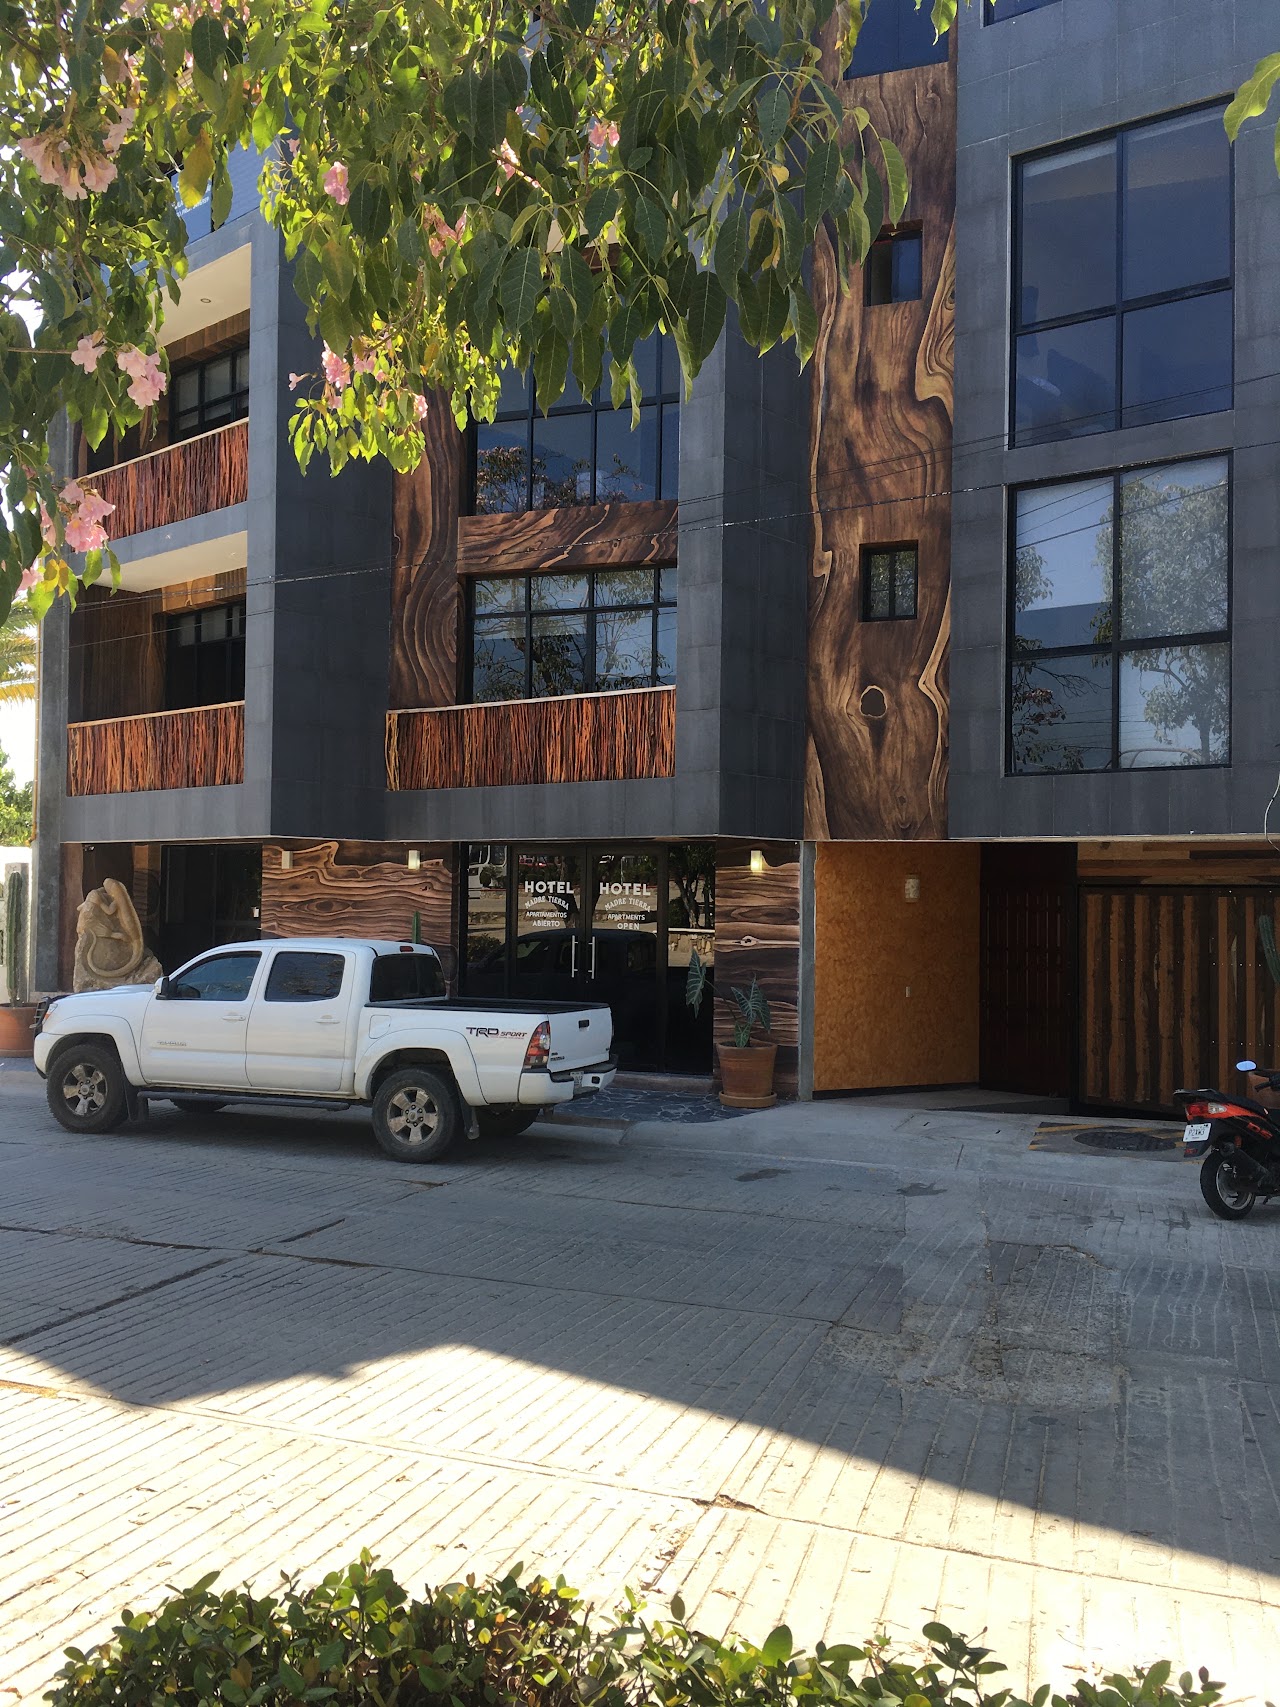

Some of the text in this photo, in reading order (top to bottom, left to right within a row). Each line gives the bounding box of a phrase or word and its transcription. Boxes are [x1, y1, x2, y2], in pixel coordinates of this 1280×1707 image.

[524, 880, 574, 894] HOTEL
[600, 882, 651, 896] HOTEL
[525, 895, 569, 911] MADRE TIERRA
[604, 897, 651, 912] MADRE TIERRA
[525, 911, 568, 919] APARTAMENTOS
[607, 913, 646, 921] APARTMENTS
[532, 919, 560, 927] ABIERTO
[617, 922, 640, 930] OPEN
[465, 1026, 500, 1038] TRD
